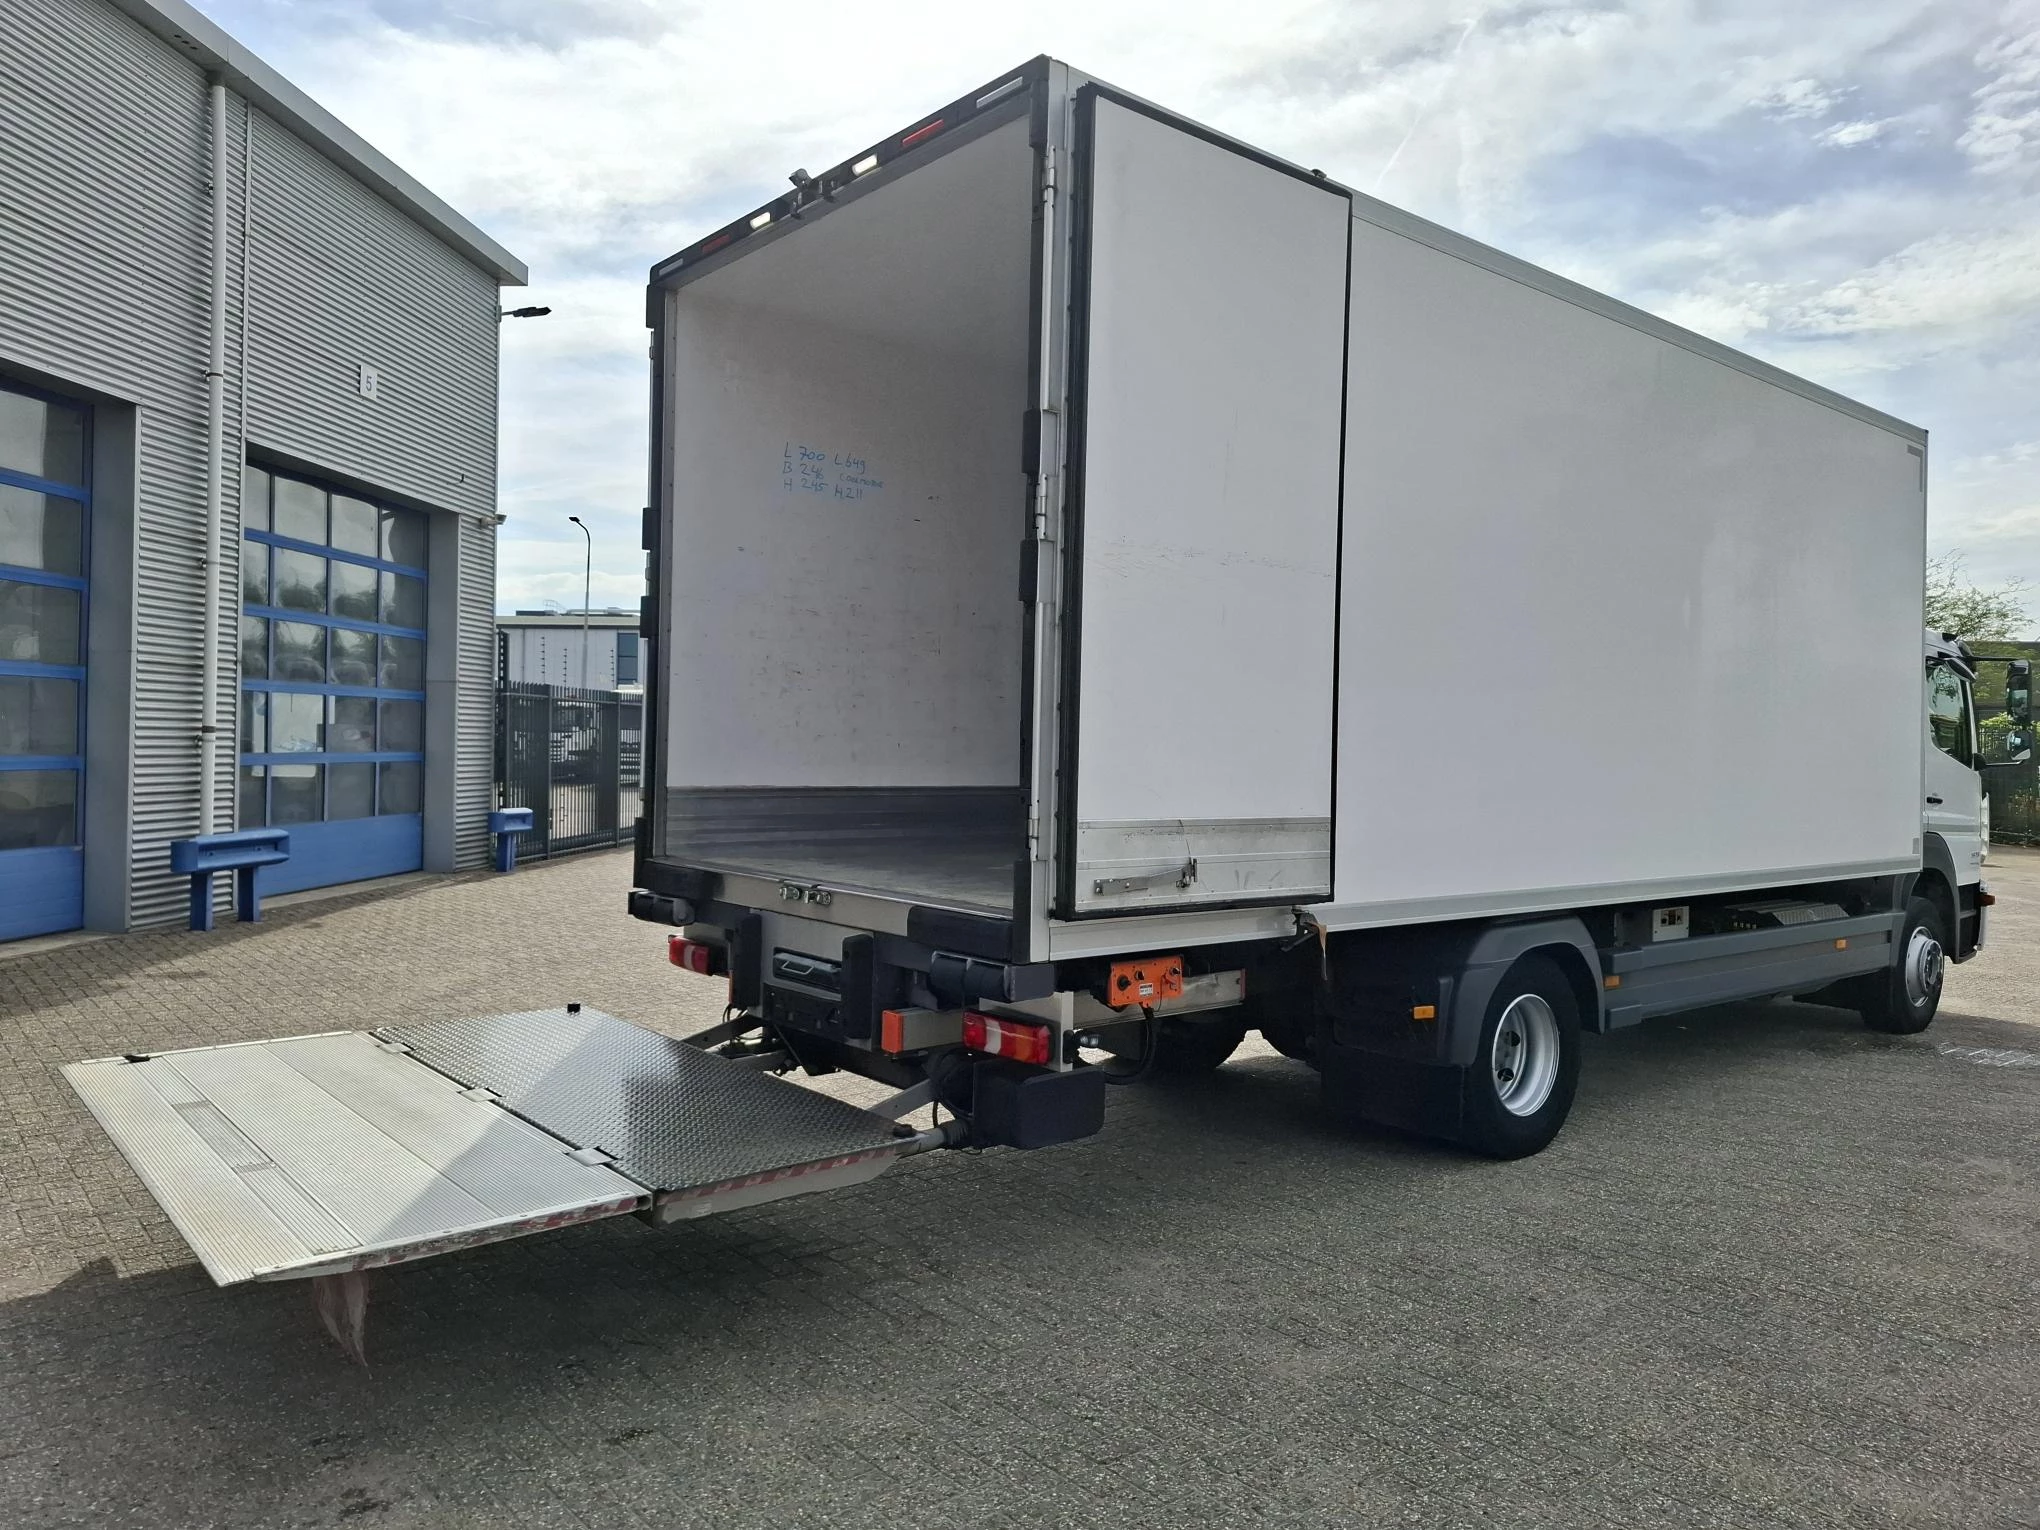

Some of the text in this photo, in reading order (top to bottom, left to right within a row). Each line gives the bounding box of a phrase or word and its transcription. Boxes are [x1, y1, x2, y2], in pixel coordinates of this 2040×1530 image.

[365, 374, 372, 392] 5
[784, 441, 792, 458] L
[798, 445, 826, 461] 700
[782, 461, 792, 474] B
[783, 478, 792, 492] H
[800, 477, 829, 492] 245
